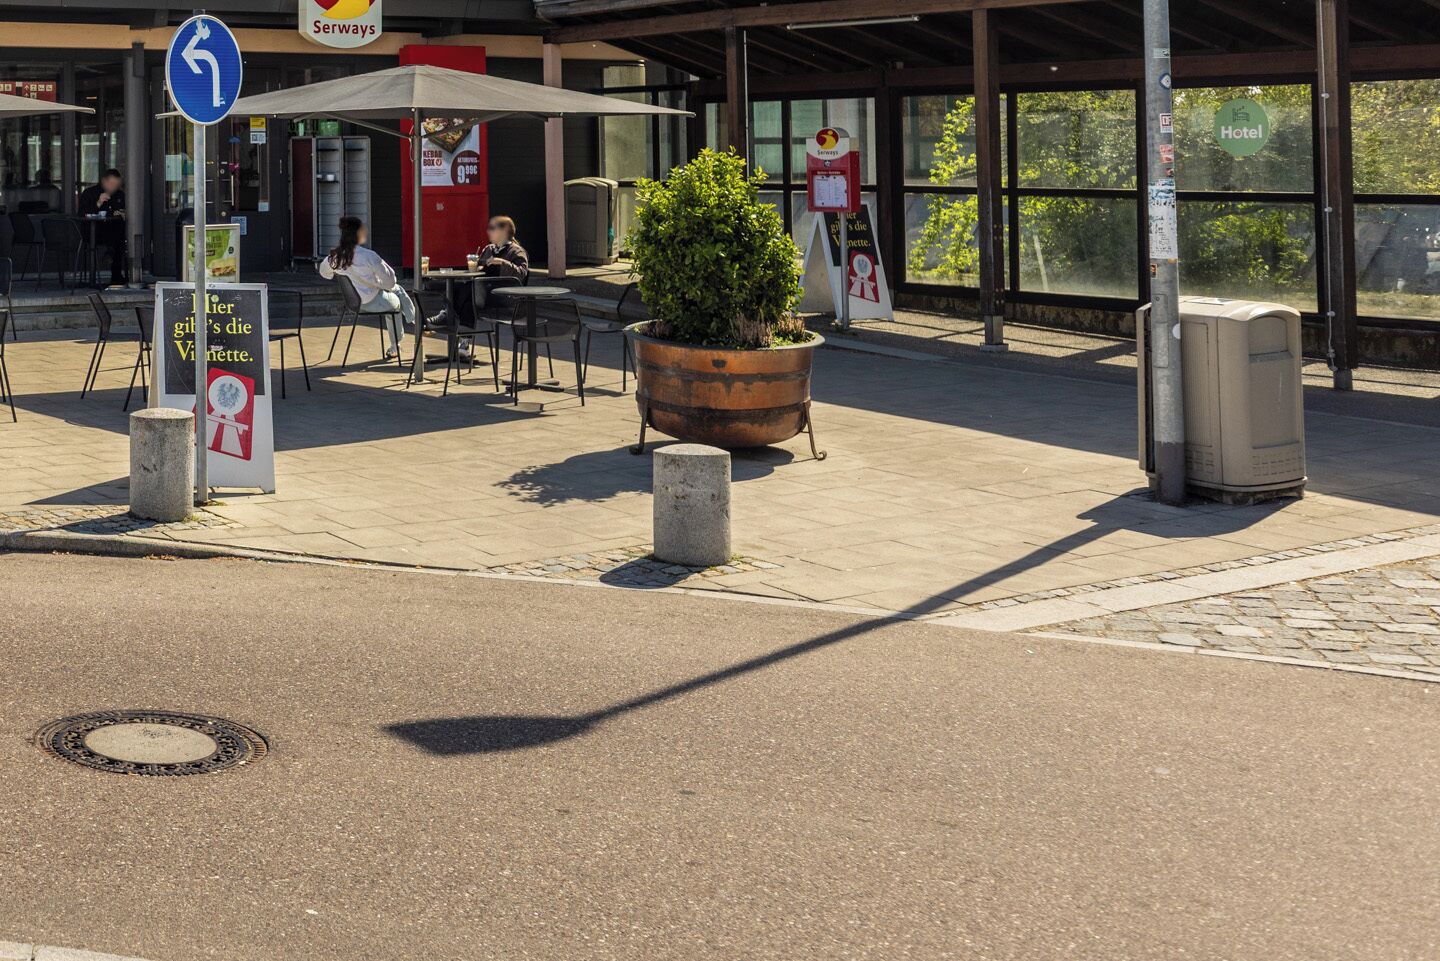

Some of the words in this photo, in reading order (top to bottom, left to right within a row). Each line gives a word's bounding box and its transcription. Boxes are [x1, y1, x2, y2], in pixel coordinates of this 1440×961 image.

[313, 20, 375, 38] Serways
[1221, 124, 1263, 139] Hotel
[225, 317, 252, 334] die
[174, 340, 254, 362] Vinette.
